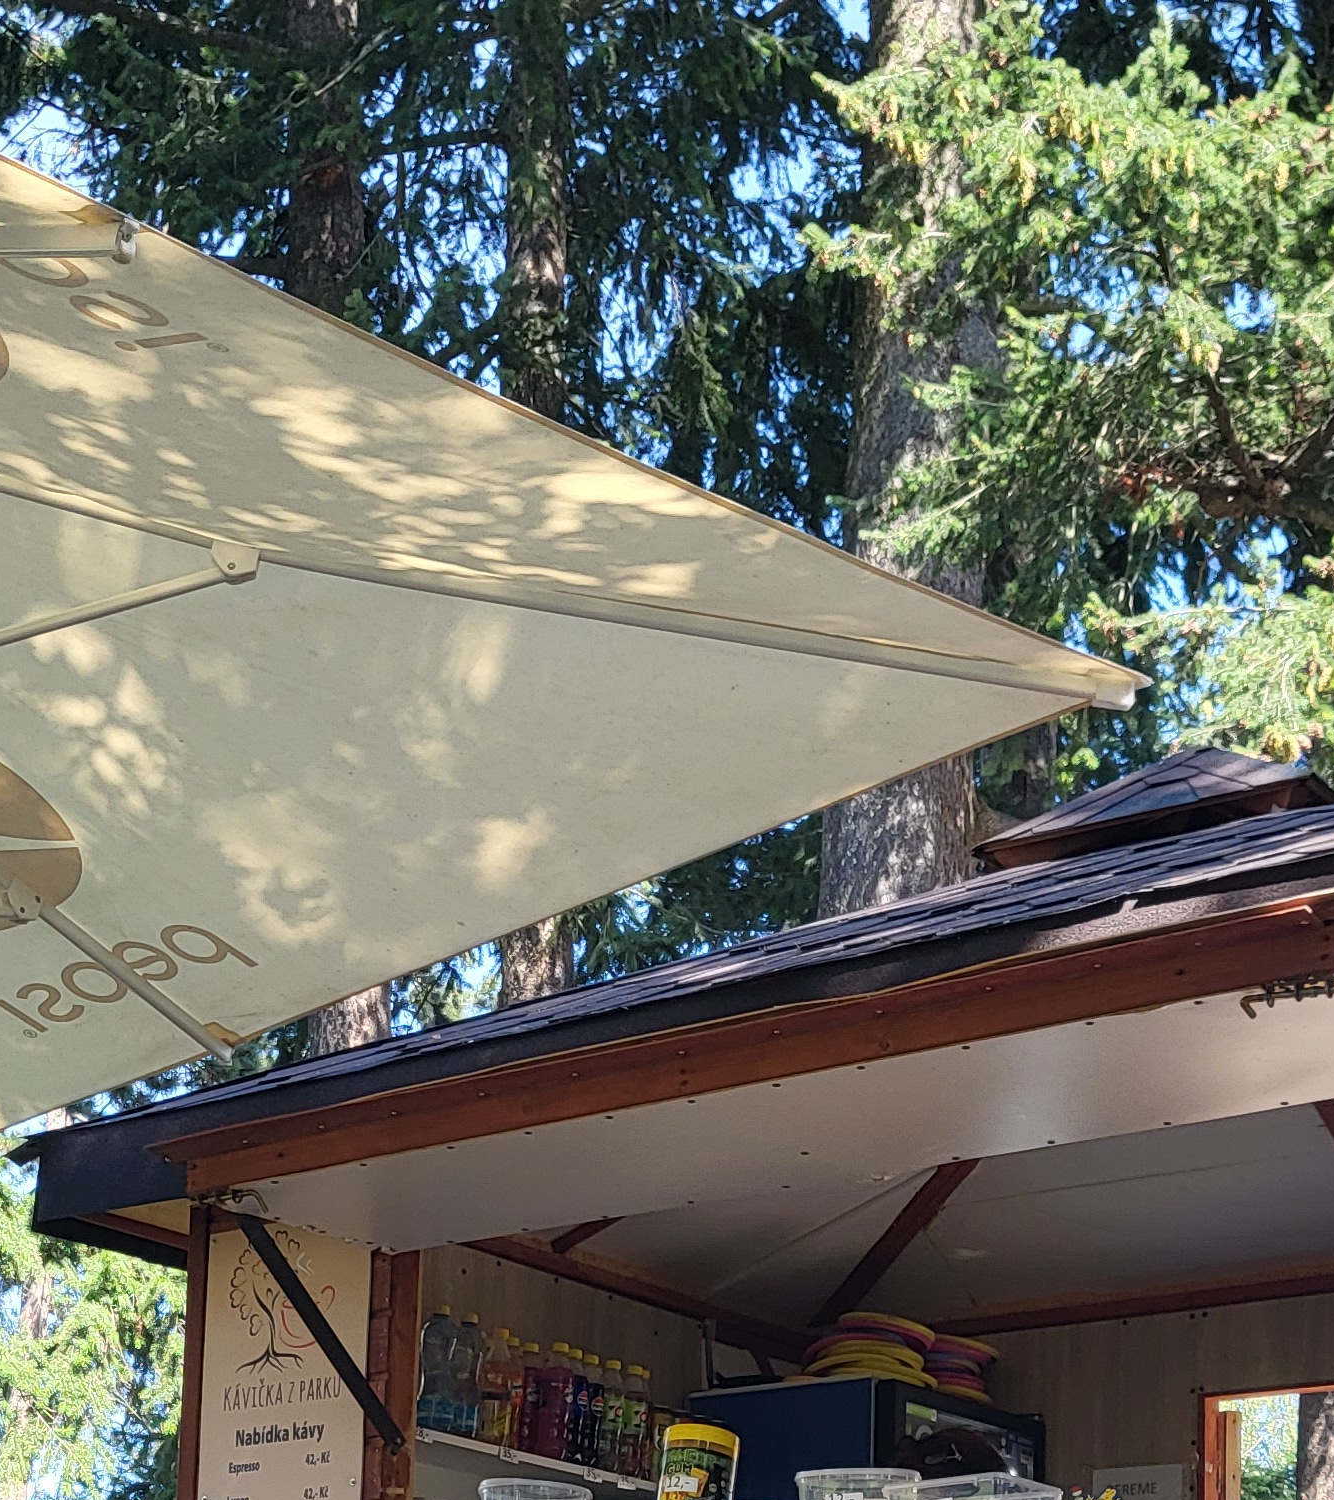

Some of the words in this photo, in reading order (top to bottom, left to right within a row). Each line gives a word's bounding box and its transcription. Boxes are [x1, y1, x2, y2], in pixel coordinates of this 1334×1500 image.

[223, 1377, 283, 1413] KÁVIČKA
[287, 1380, 296, 1405] Z
[298, 1374, 342, 1403] PARKU
[235, 1424, 289, 1448] Nabídka
[292, 1421, 325, 1445] kávy
[228, 1461, 260, 1476] Espresso
[305, 1453, 319, 1465] 42,-
[321, 1451, 330, 1463] Kč
[303, 1488, 318, 1500] 42,-
[319, 1486, 329, 1498] Kč
[666, 1476, 691, 1490] 12,-
